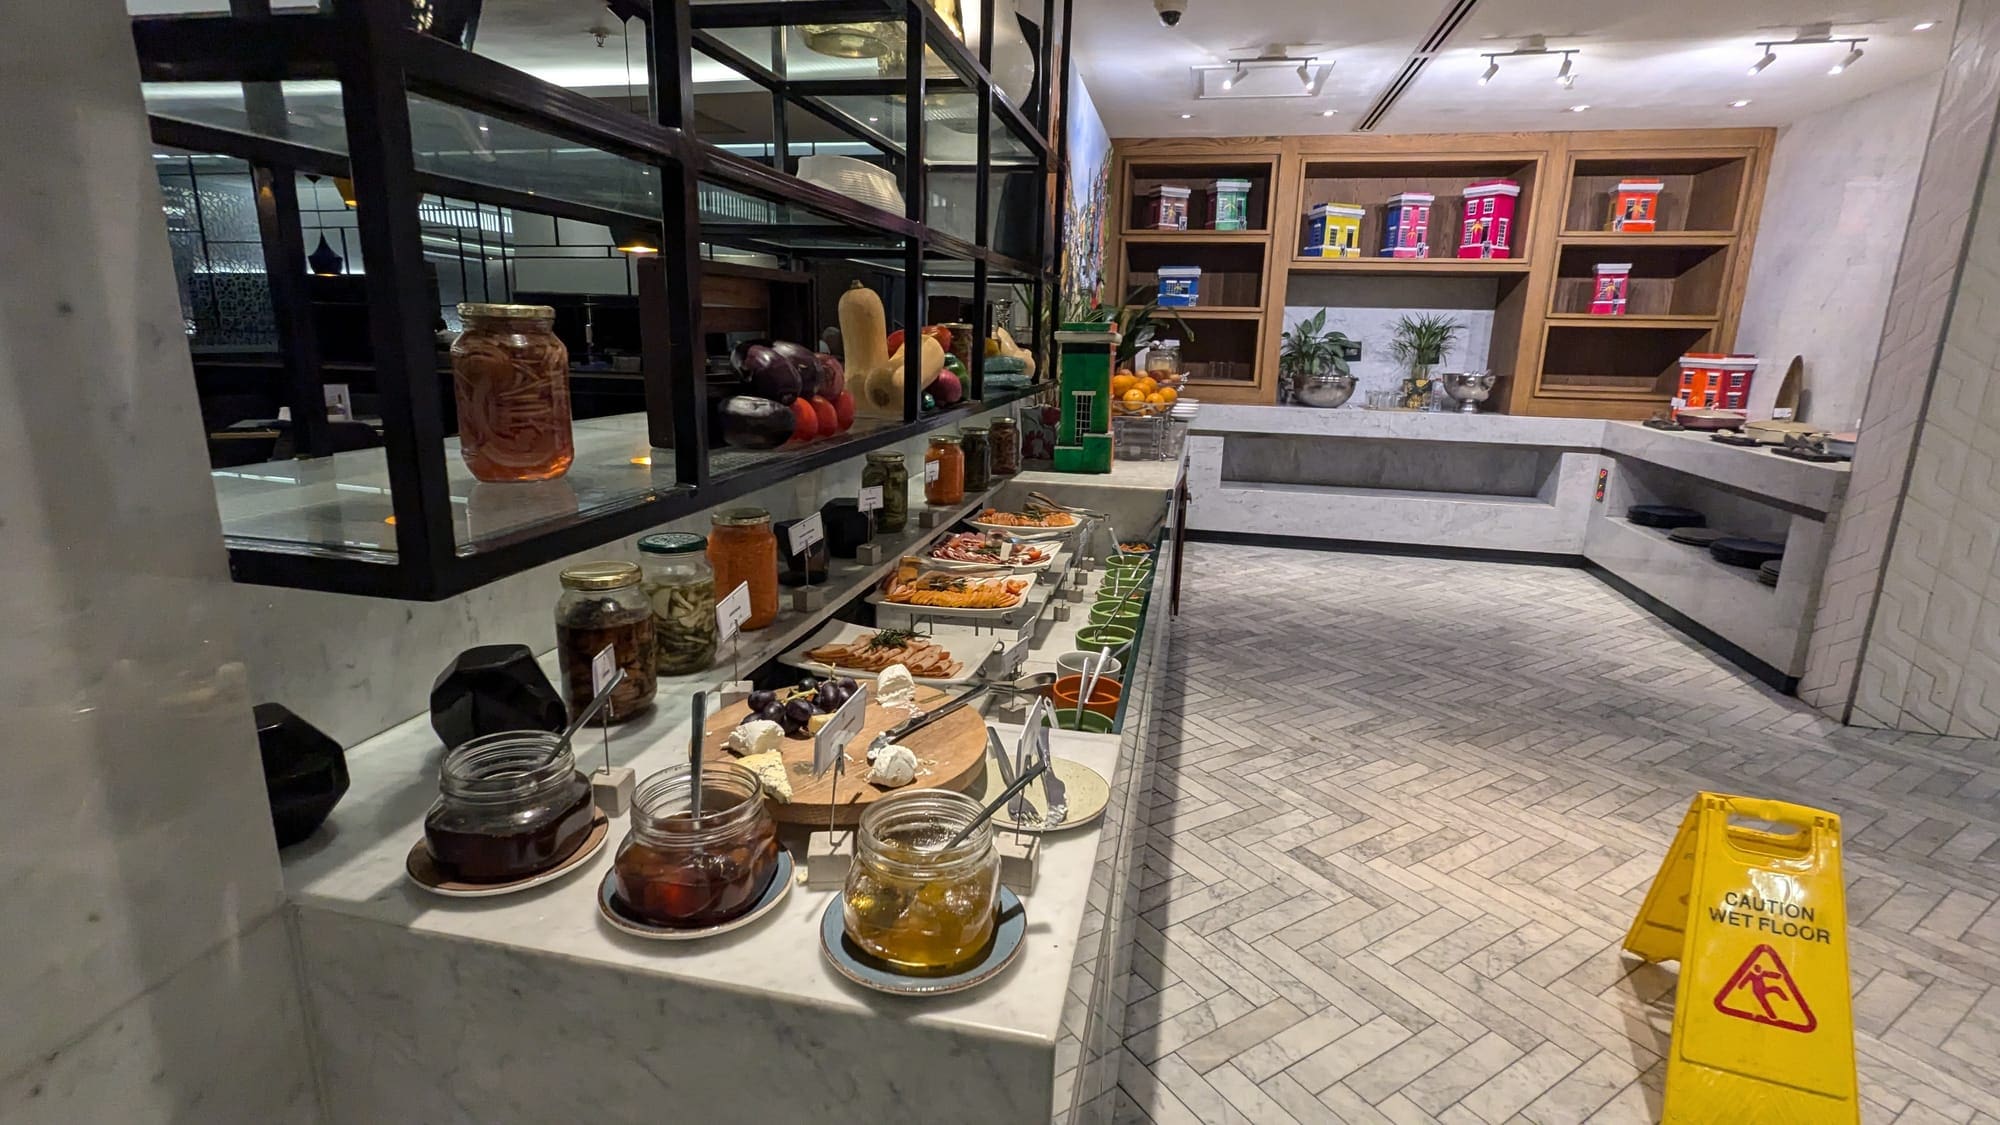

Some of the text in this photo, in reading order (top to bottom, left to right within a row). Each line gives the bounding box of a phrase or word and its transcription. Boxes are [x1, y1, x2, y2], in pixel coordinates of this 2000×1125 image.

[1725, 892, 1815, 922] CAUTION
[1709, 907, 1830, 944] WET FLOOR
